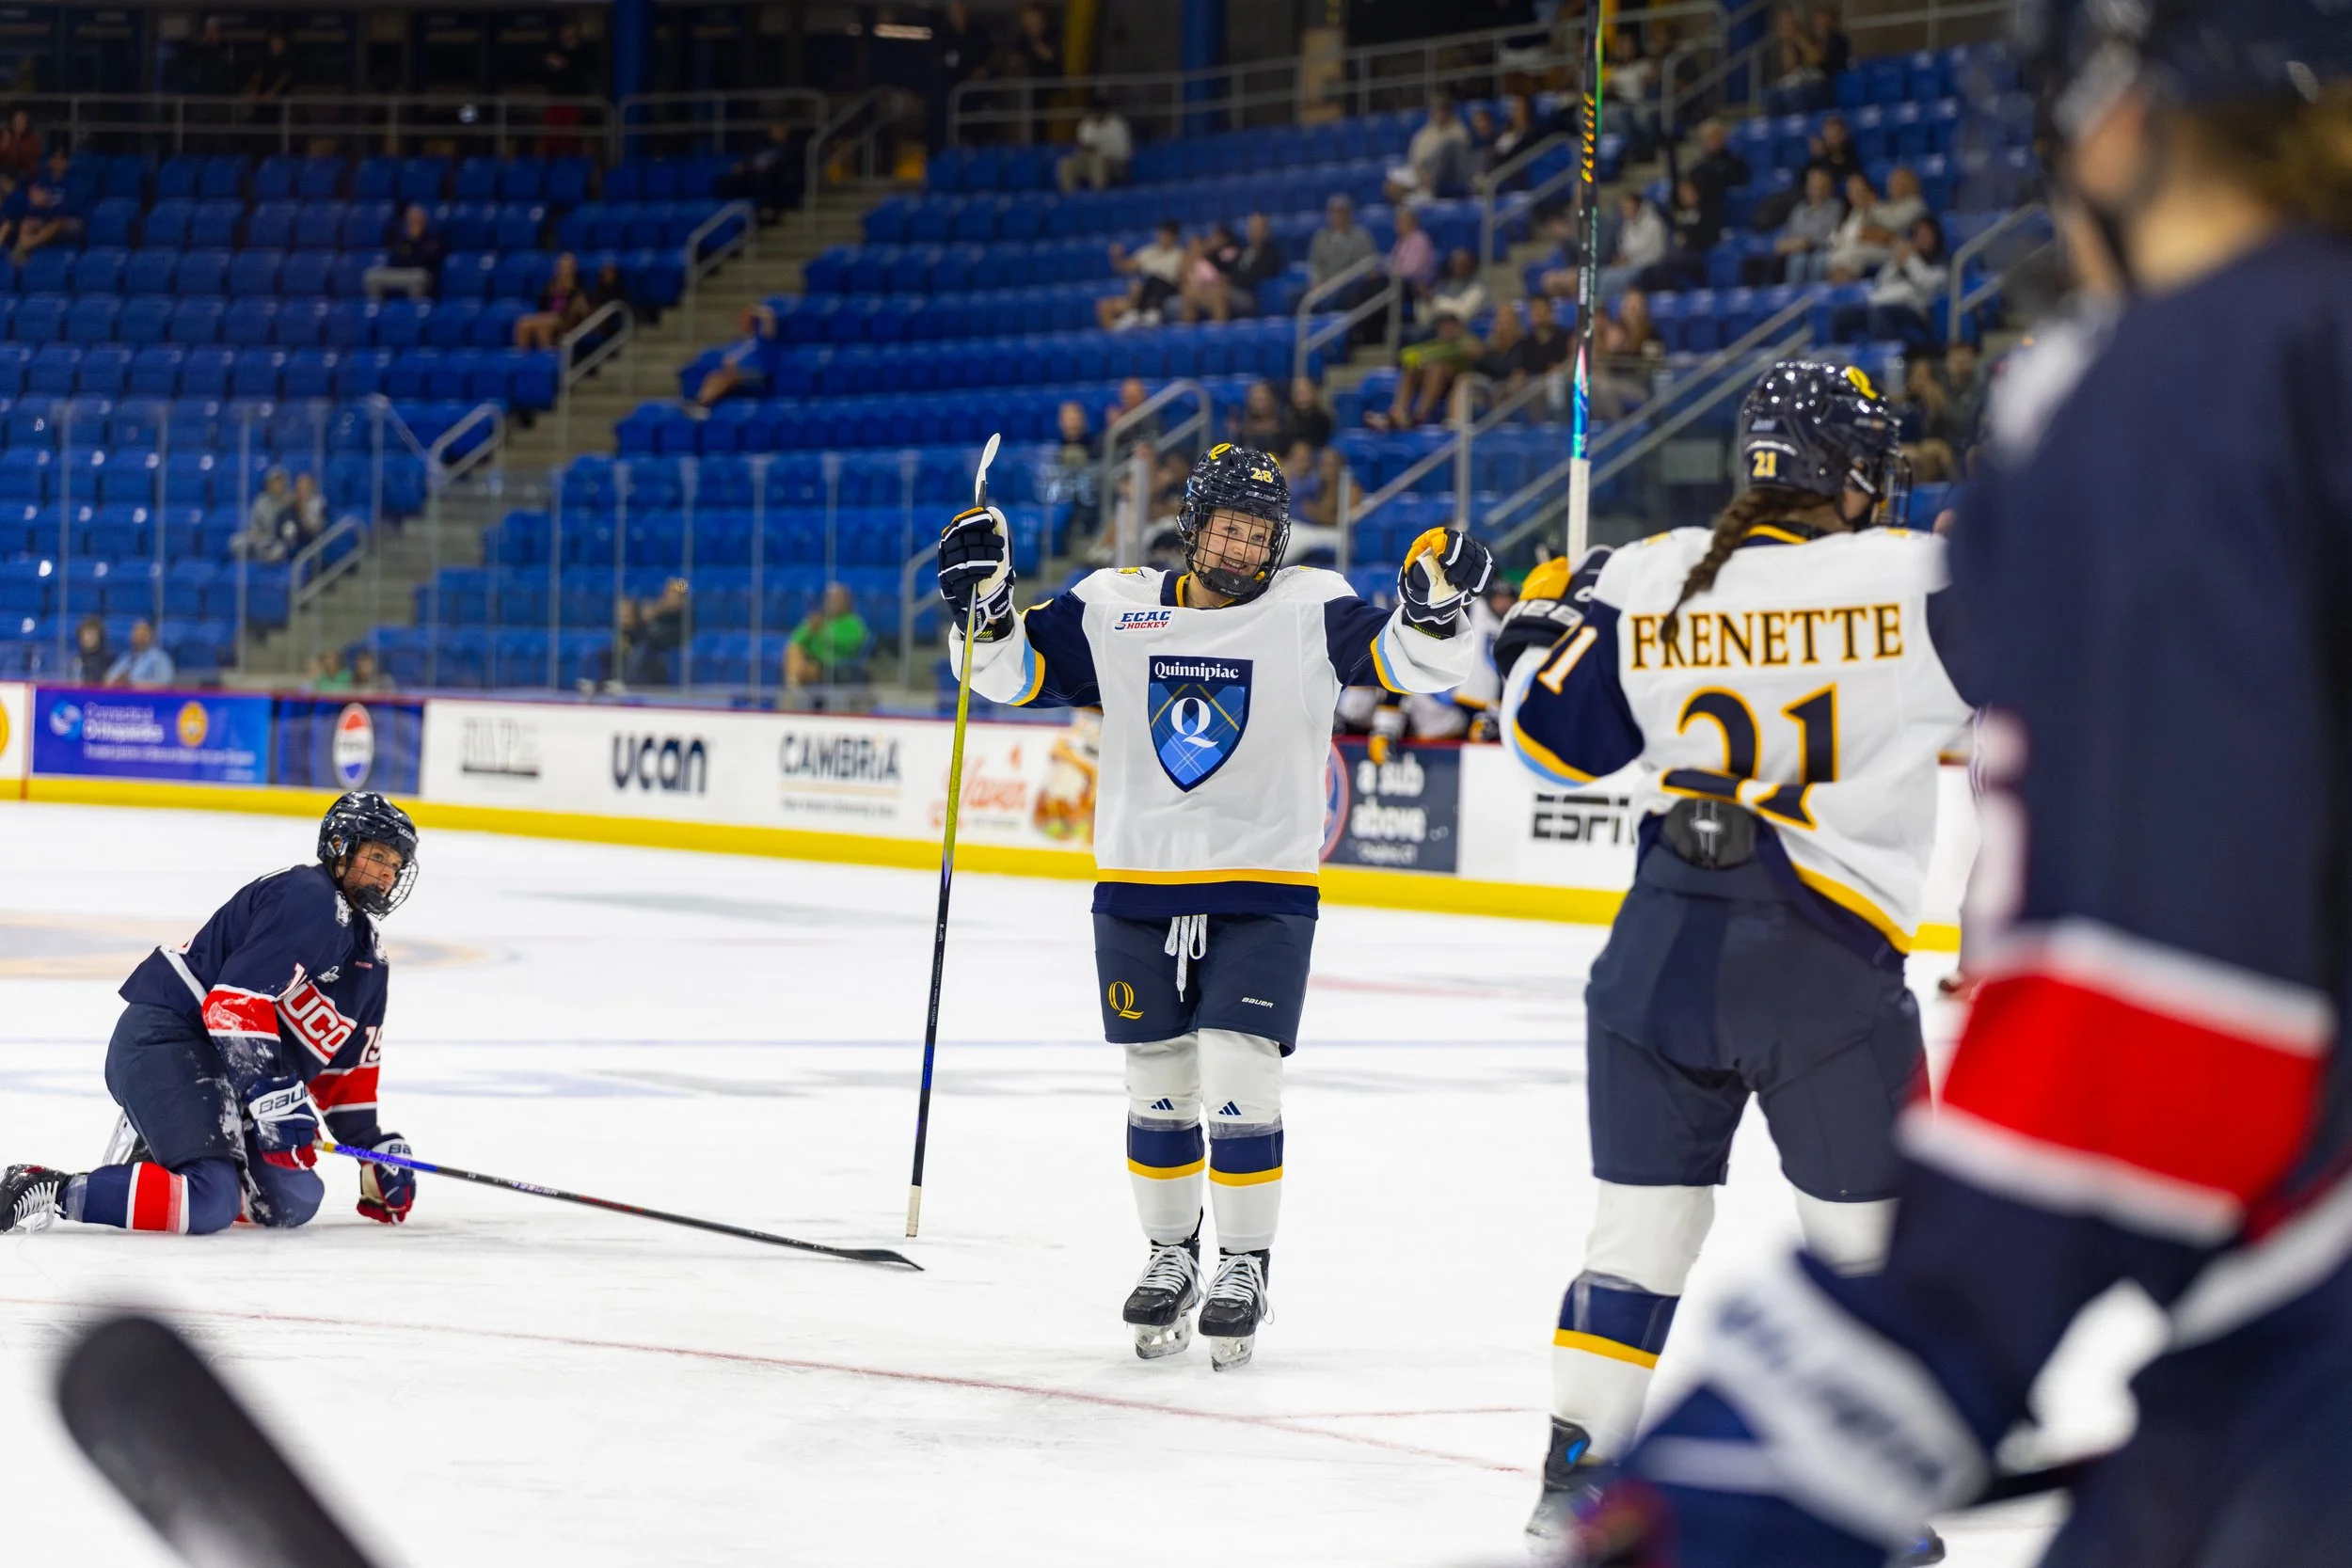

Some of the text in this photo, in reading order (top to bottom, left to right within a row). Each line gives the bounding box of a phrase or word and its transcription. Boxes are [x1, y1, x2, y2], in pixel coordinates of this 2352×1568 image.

[1249, 467, 1274, 483] 28
[1752, 451, 1777, 478] 21
[1120, 610, 1172, 623] ECAC
[1126, 621, 1168, 629] HOCKEY
[1630, 603, 1902, 670] FRENETTE
[1154, 661, 1239, 681] Quinnipiac
[1170, 697, 1219, 749] Q
[1677, 681, 1840, 786] 21
[780, 734, 901, 782] CAMBRIA
[1356, 752, 1425, 797] a sub
[1351, 795, 1427, 843] above
[1107, 981, 1144, 1020] Q
[1241, 997, 1274, 1008] BAUER
